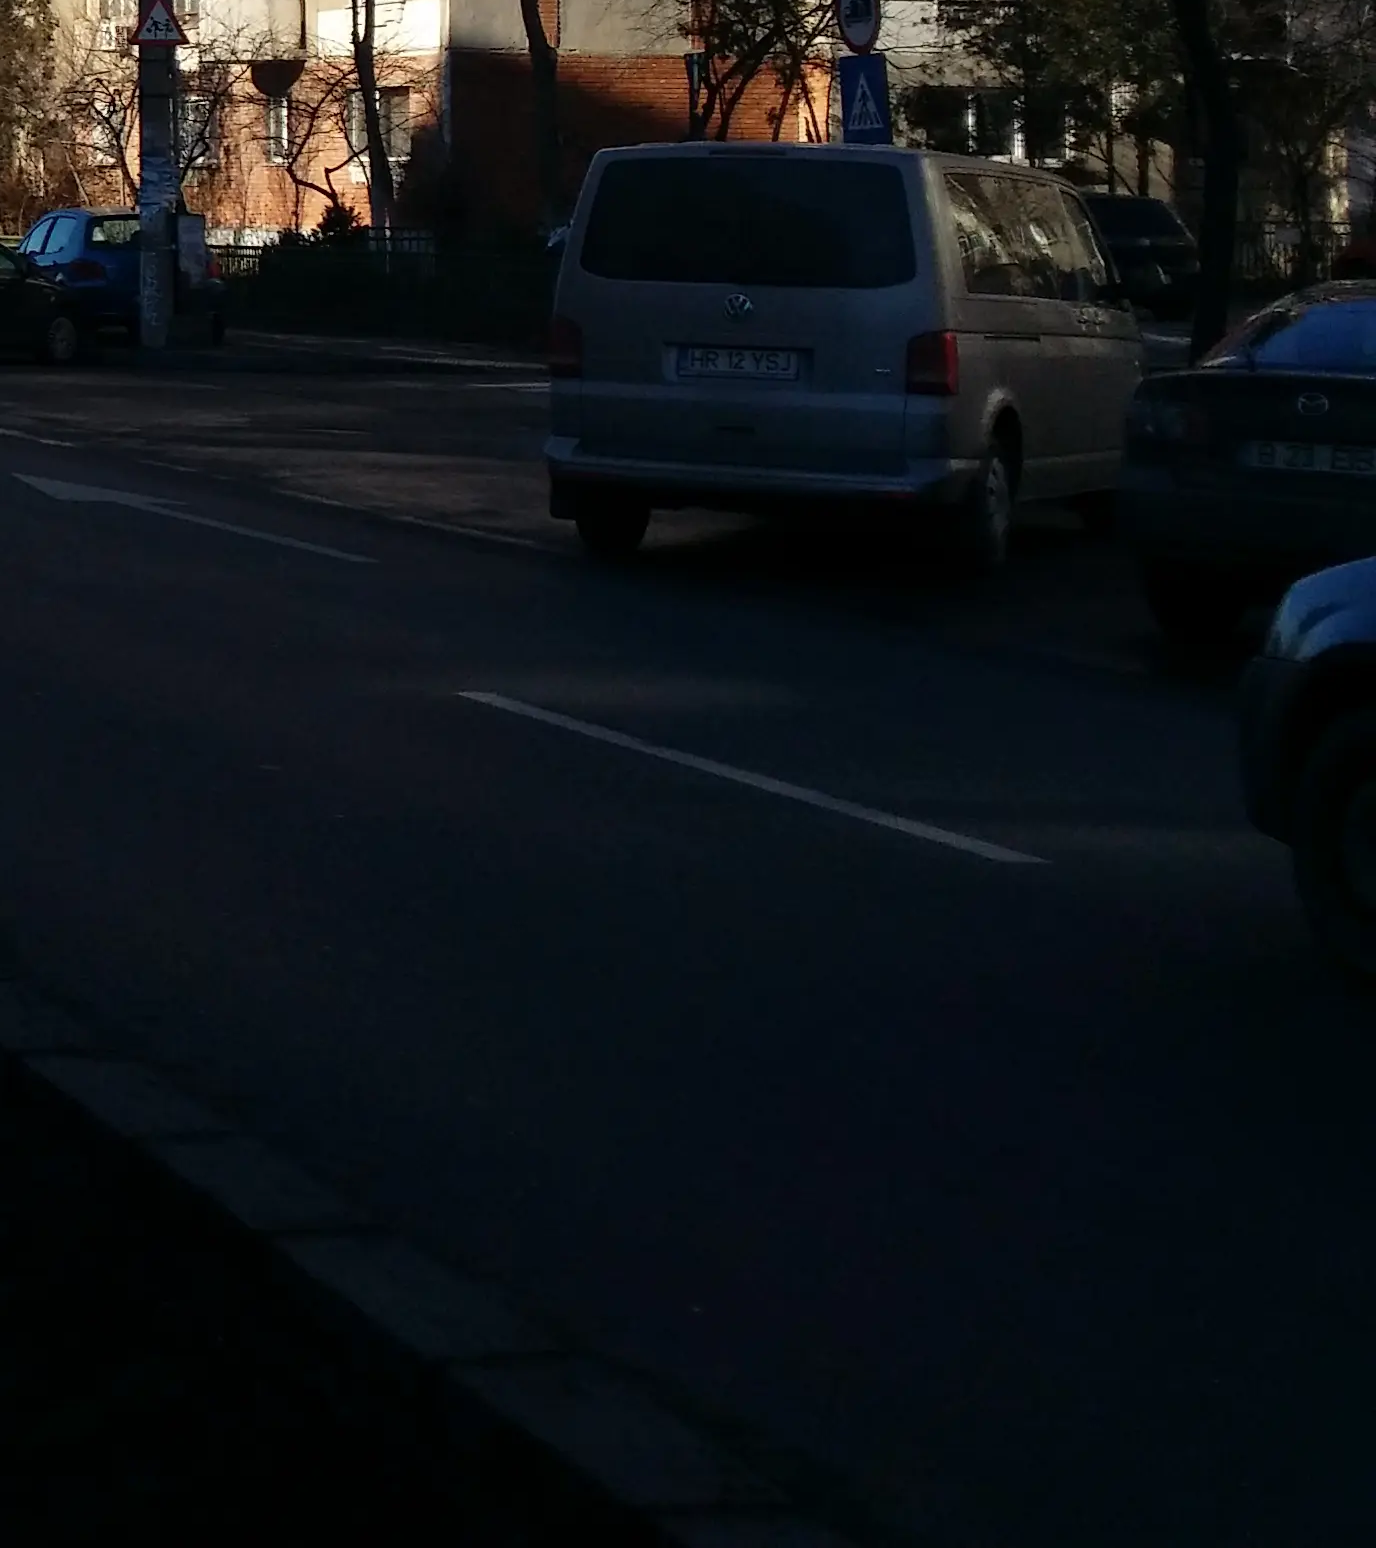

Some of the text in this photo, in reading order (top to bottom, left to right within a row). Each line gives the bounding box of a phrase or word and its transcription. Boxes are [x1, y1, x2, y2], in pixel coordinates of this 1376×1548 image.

[690, 349, 791, 372] HR 12 YSJ
